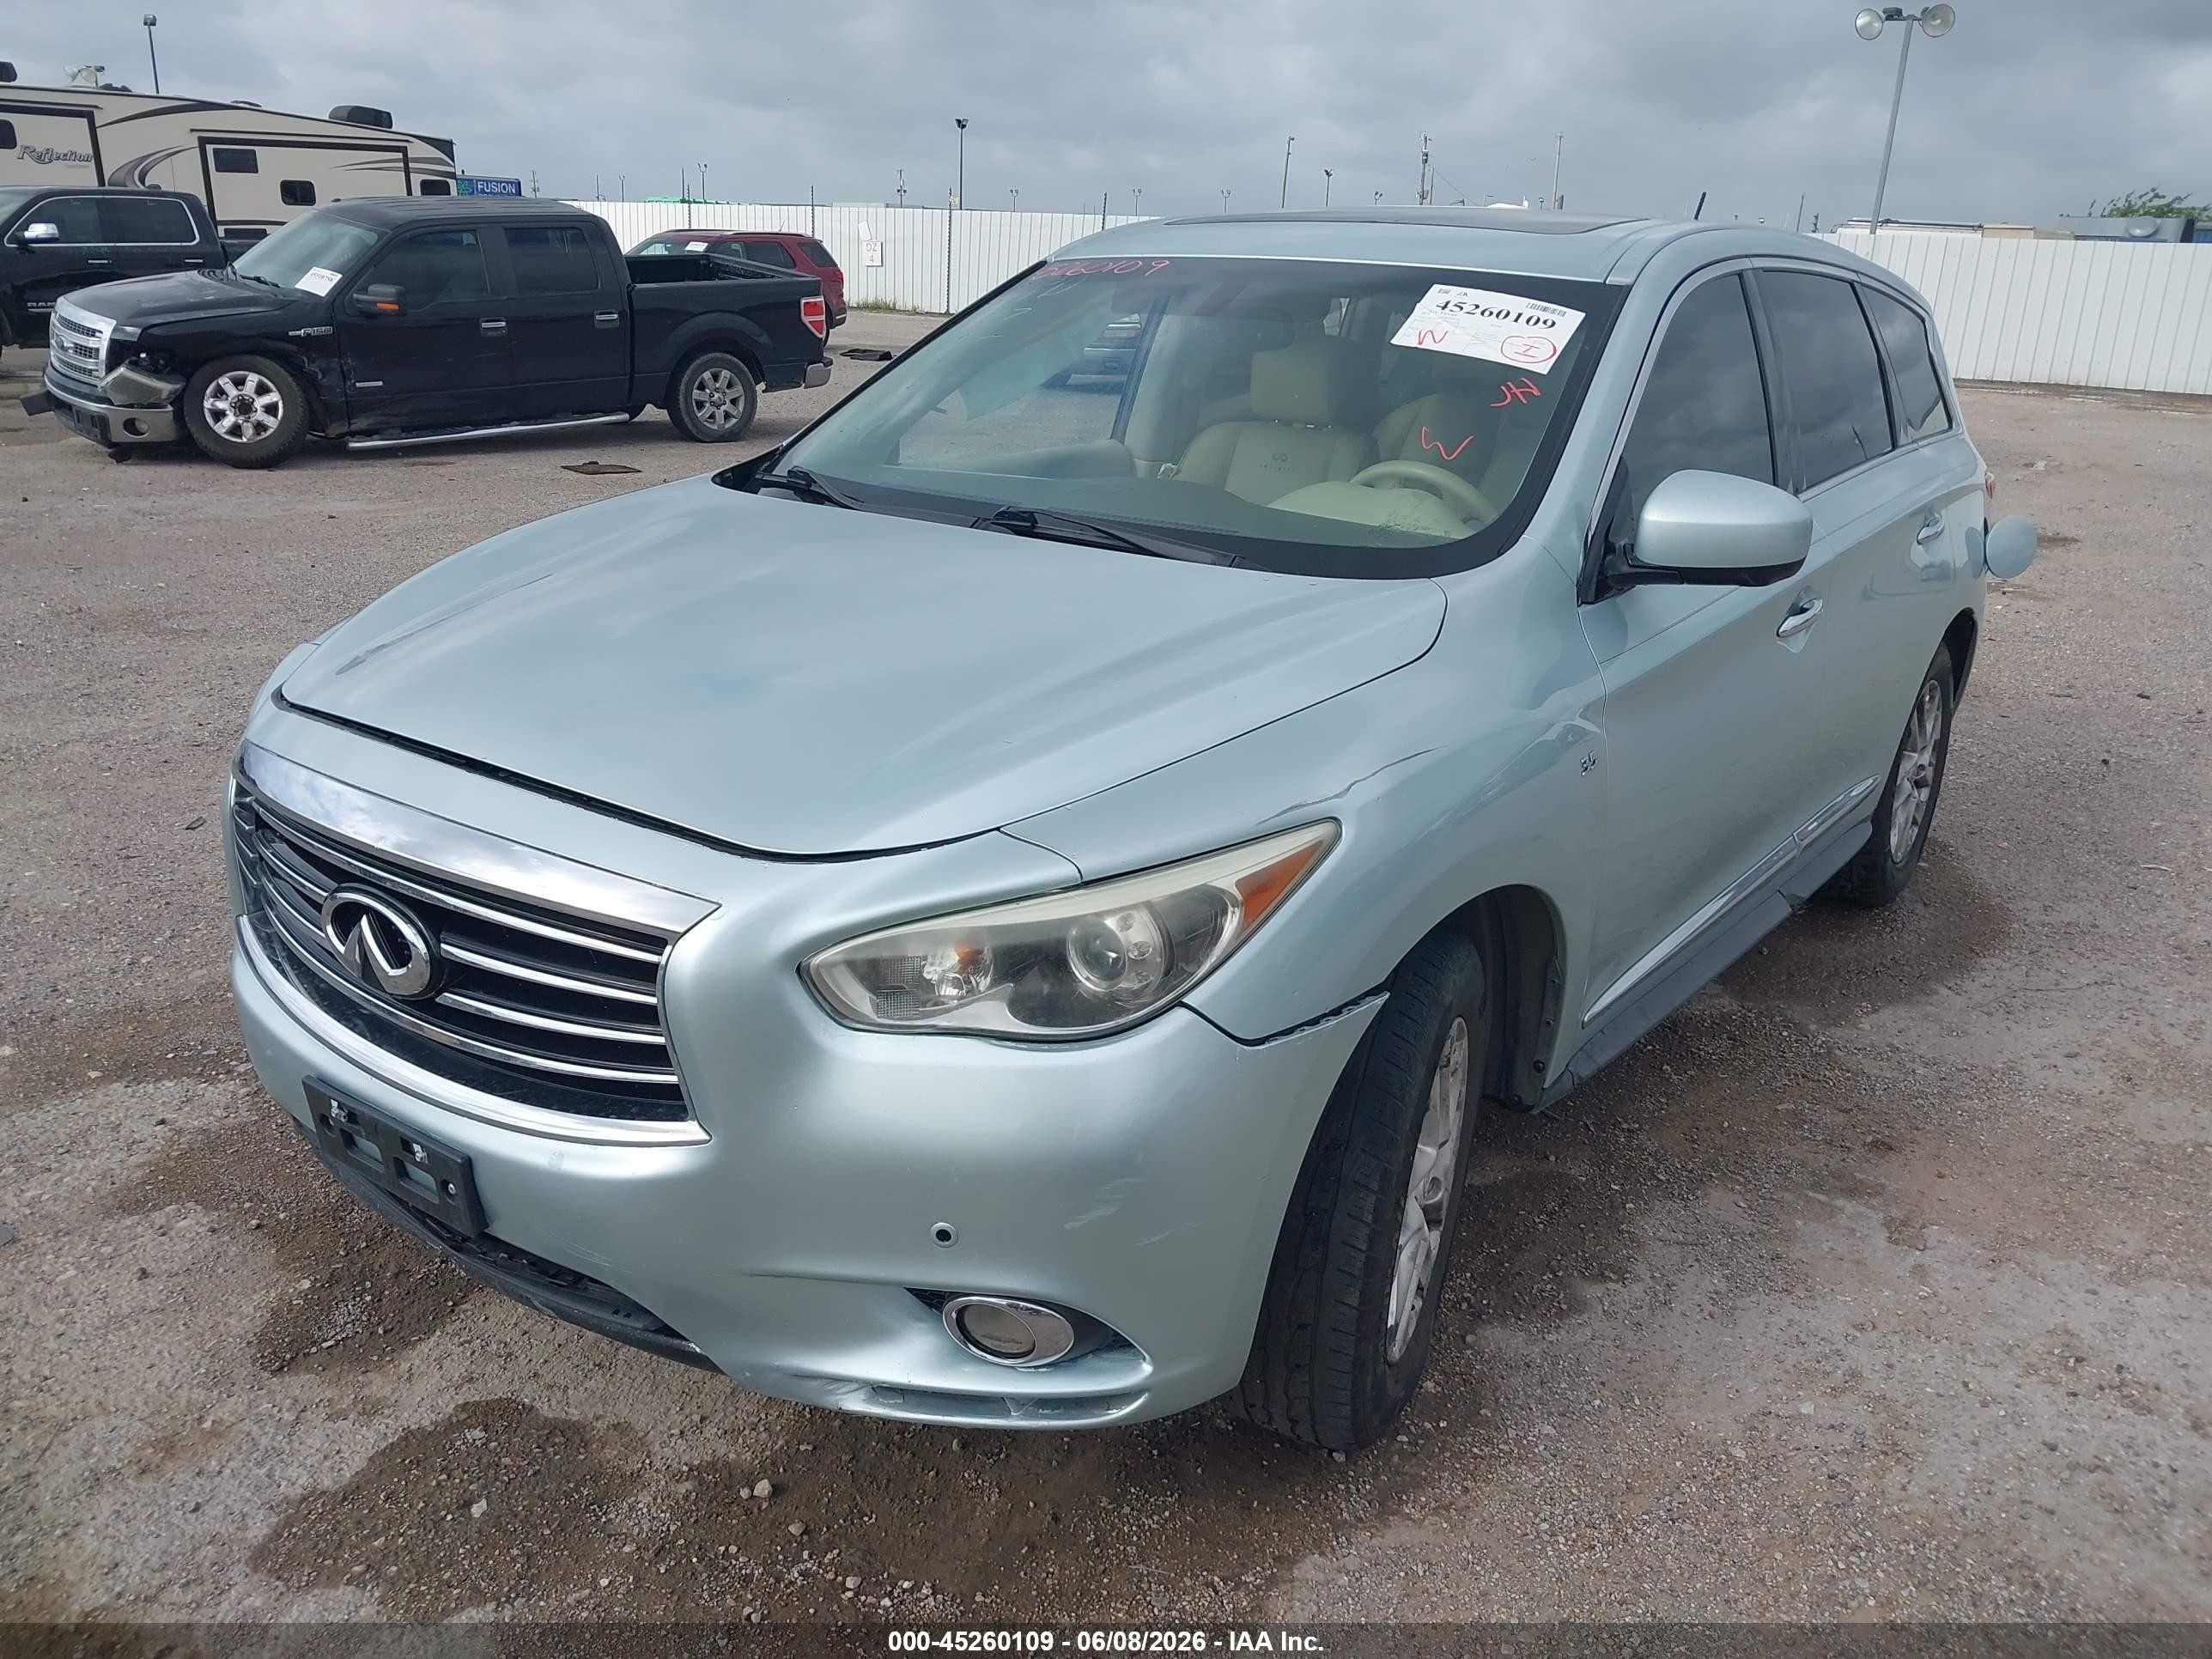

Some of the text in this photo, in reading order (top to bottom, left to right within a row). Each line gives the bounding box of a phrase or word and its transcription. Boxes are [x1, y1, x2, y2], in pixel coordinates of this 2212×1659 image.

[17, 145, 94, 165] Reflection
[477, 180, 516, 194] FUSION
[1435, 300, 1557, 330] 45260109
